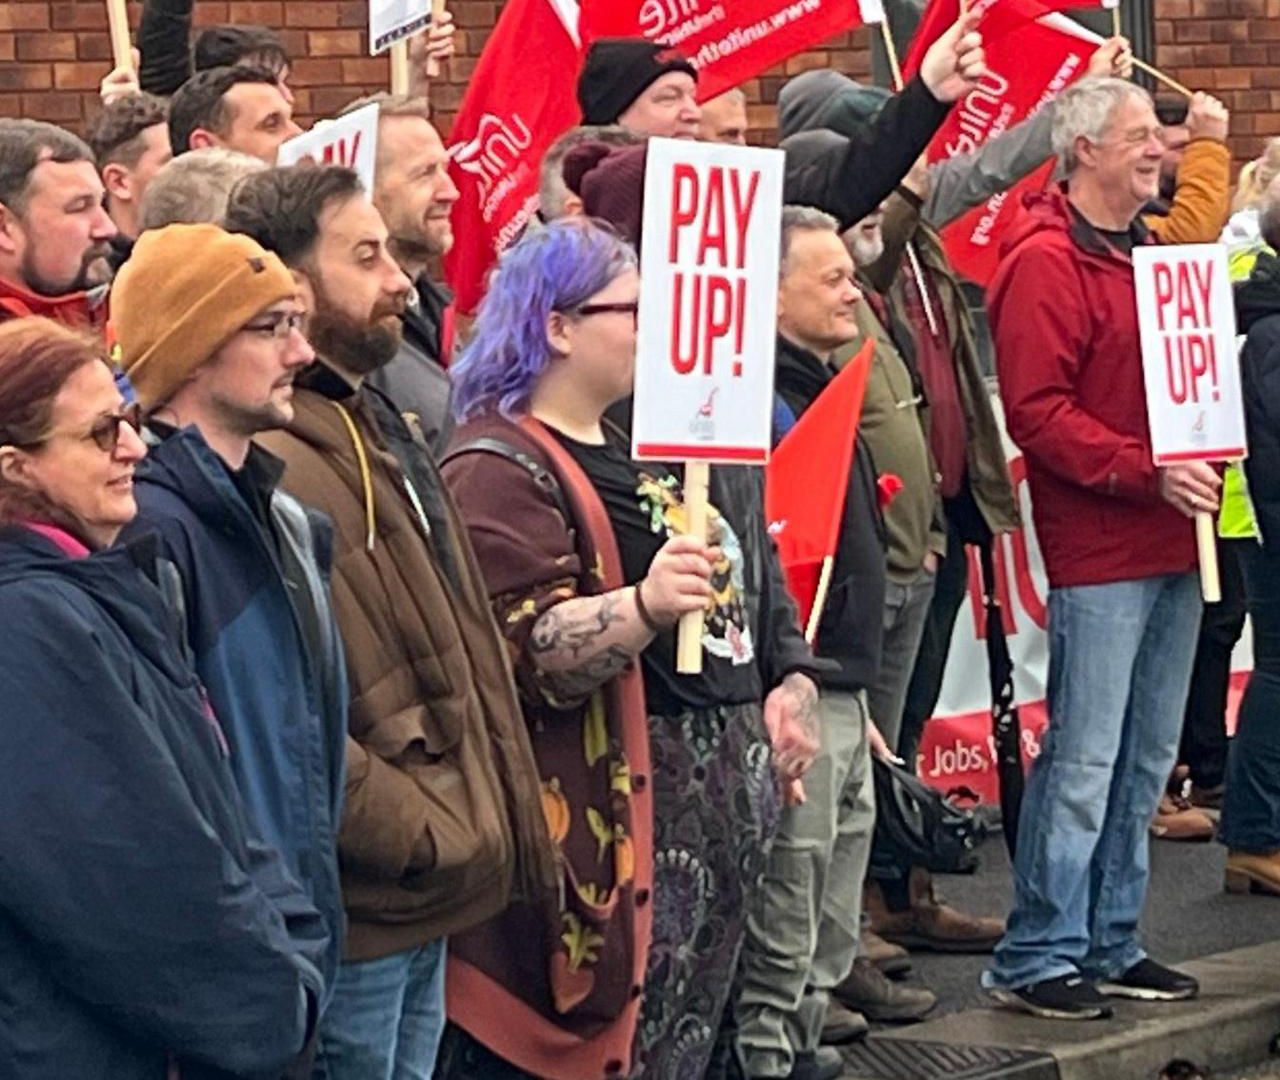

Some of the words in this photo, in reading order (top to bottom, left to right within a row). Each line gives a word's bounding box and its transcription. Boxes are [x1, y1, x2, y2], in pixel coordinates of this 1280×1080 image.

[668, 162, 761, 270] PAY
[669, 271, 748, 378] UP!
[1152, 260, 1214, 331] PAY
[1164, 333, 1220, 405] UP!
[928, 738, 989, 778] Jobs,
